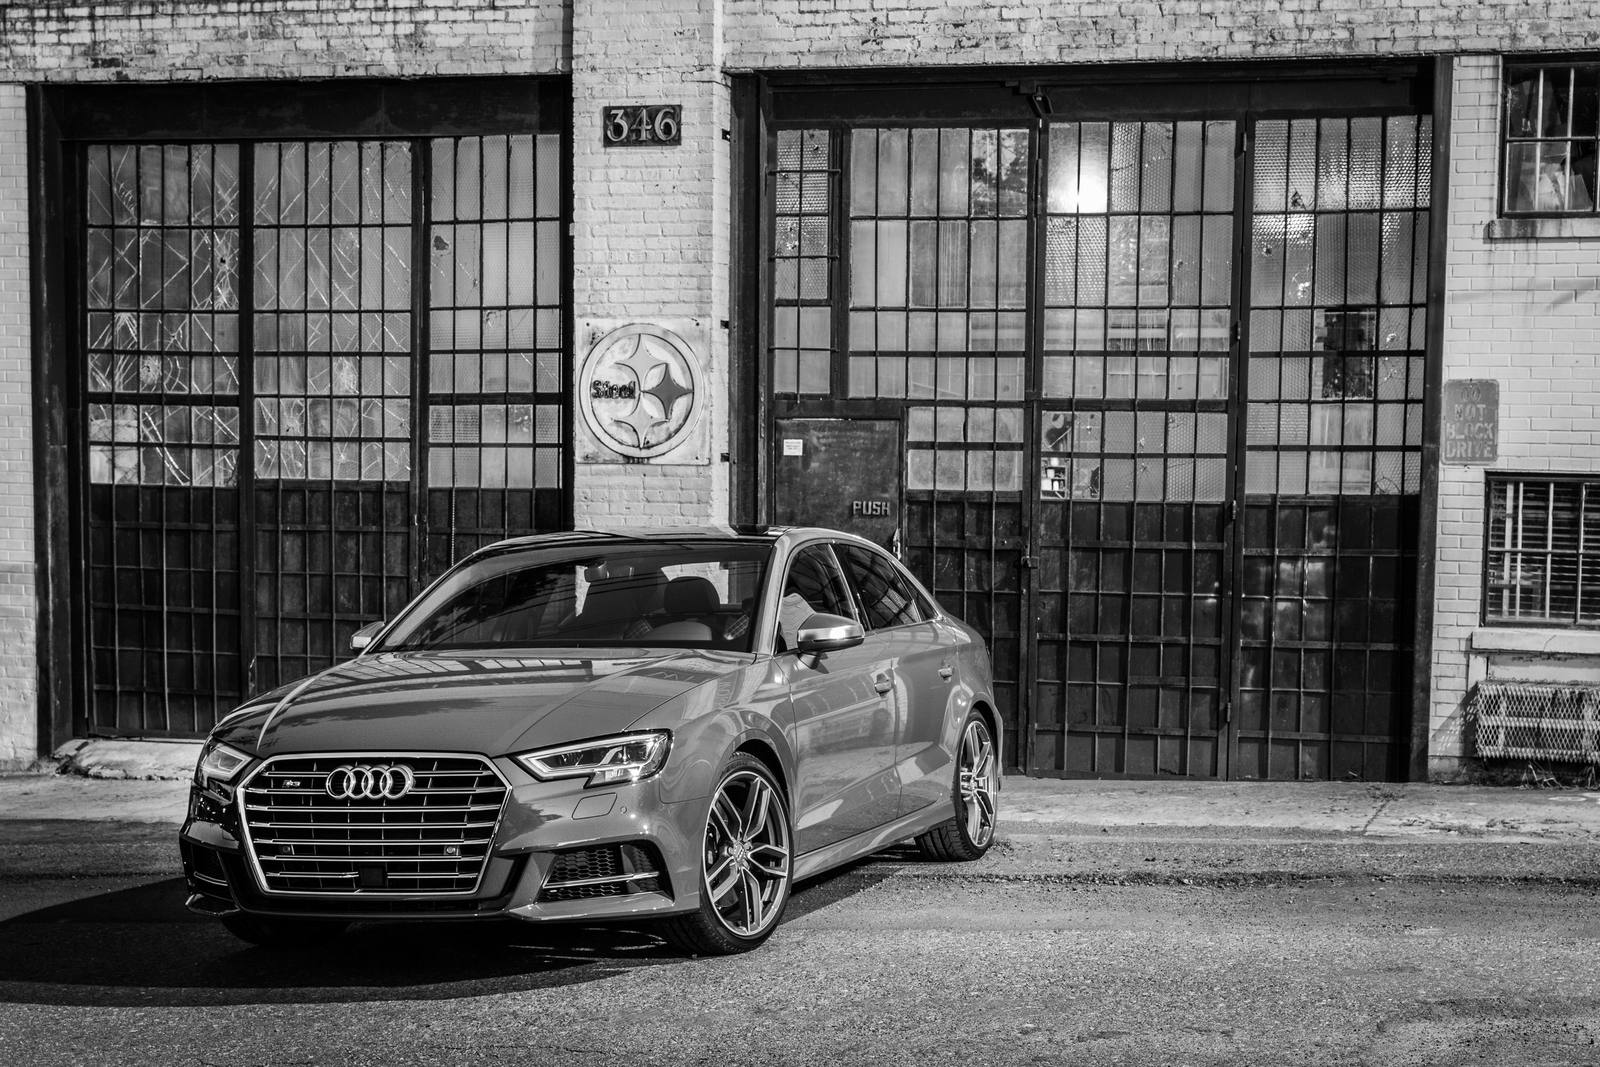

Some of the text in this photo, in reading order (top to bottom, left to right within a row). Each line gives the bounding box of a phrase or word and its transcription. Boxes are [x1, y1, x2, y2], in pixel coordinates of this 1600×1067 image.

[606, 107, 678, 142] 346
[1454, 403, 1487, 421] NOT
[1445, 422, 1494, 440] BLOCK
[1445, 440, 1494, 458] DRIVE
[852, 500, 891, 516] PUSH
